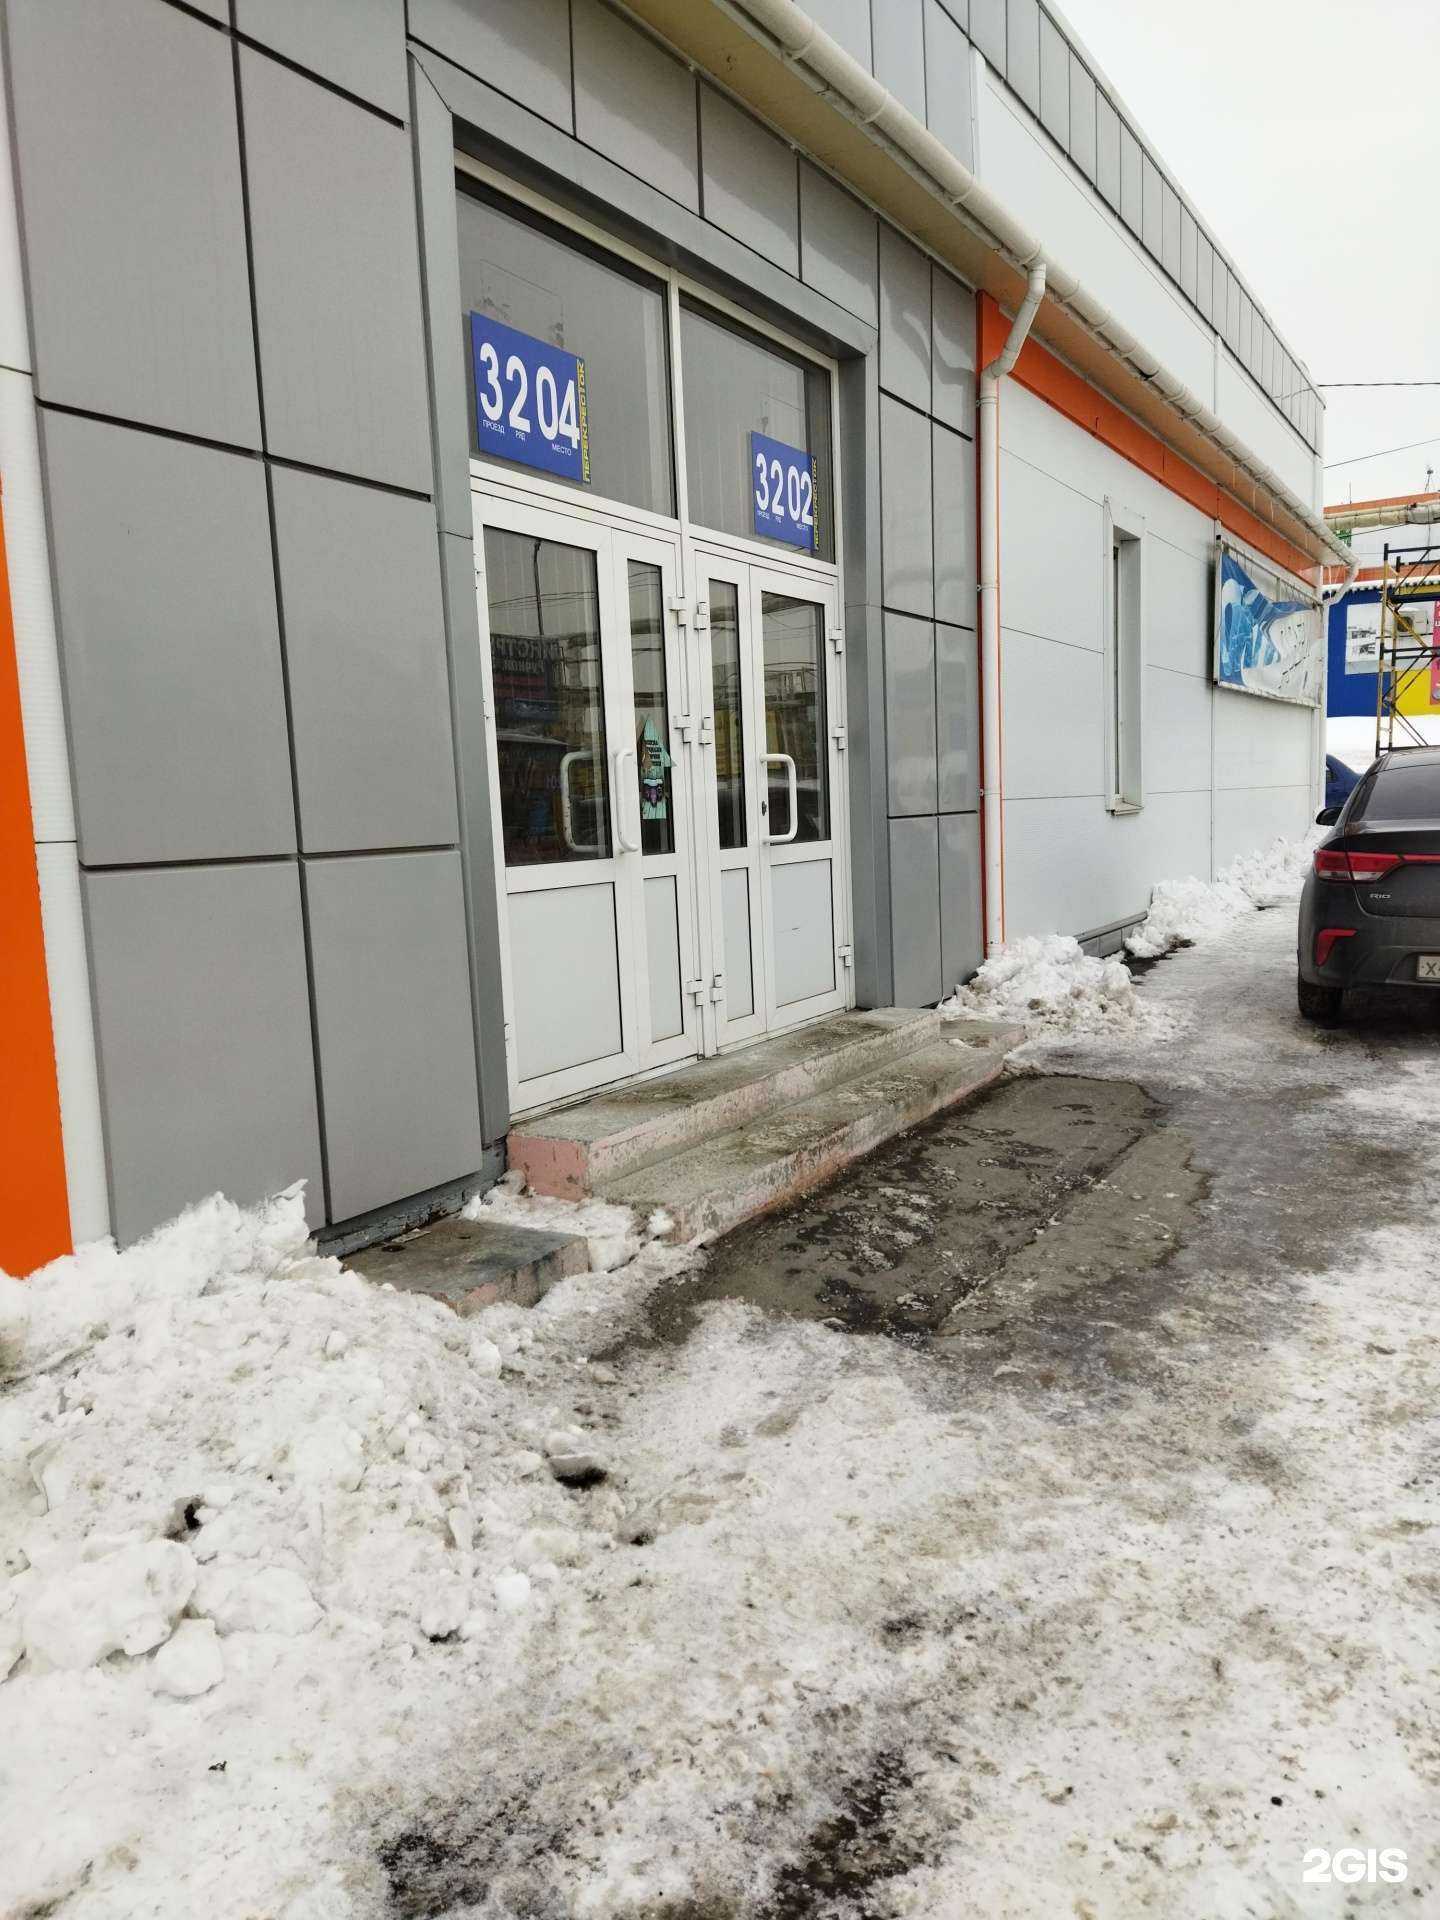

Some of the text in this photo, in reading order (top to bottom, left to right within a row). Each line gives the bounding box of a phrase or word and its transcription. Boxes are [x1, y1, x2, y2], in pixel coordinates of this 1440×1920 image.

[482, 419, 572, 456] ПРОЕЗД РЯД МЕСТО
